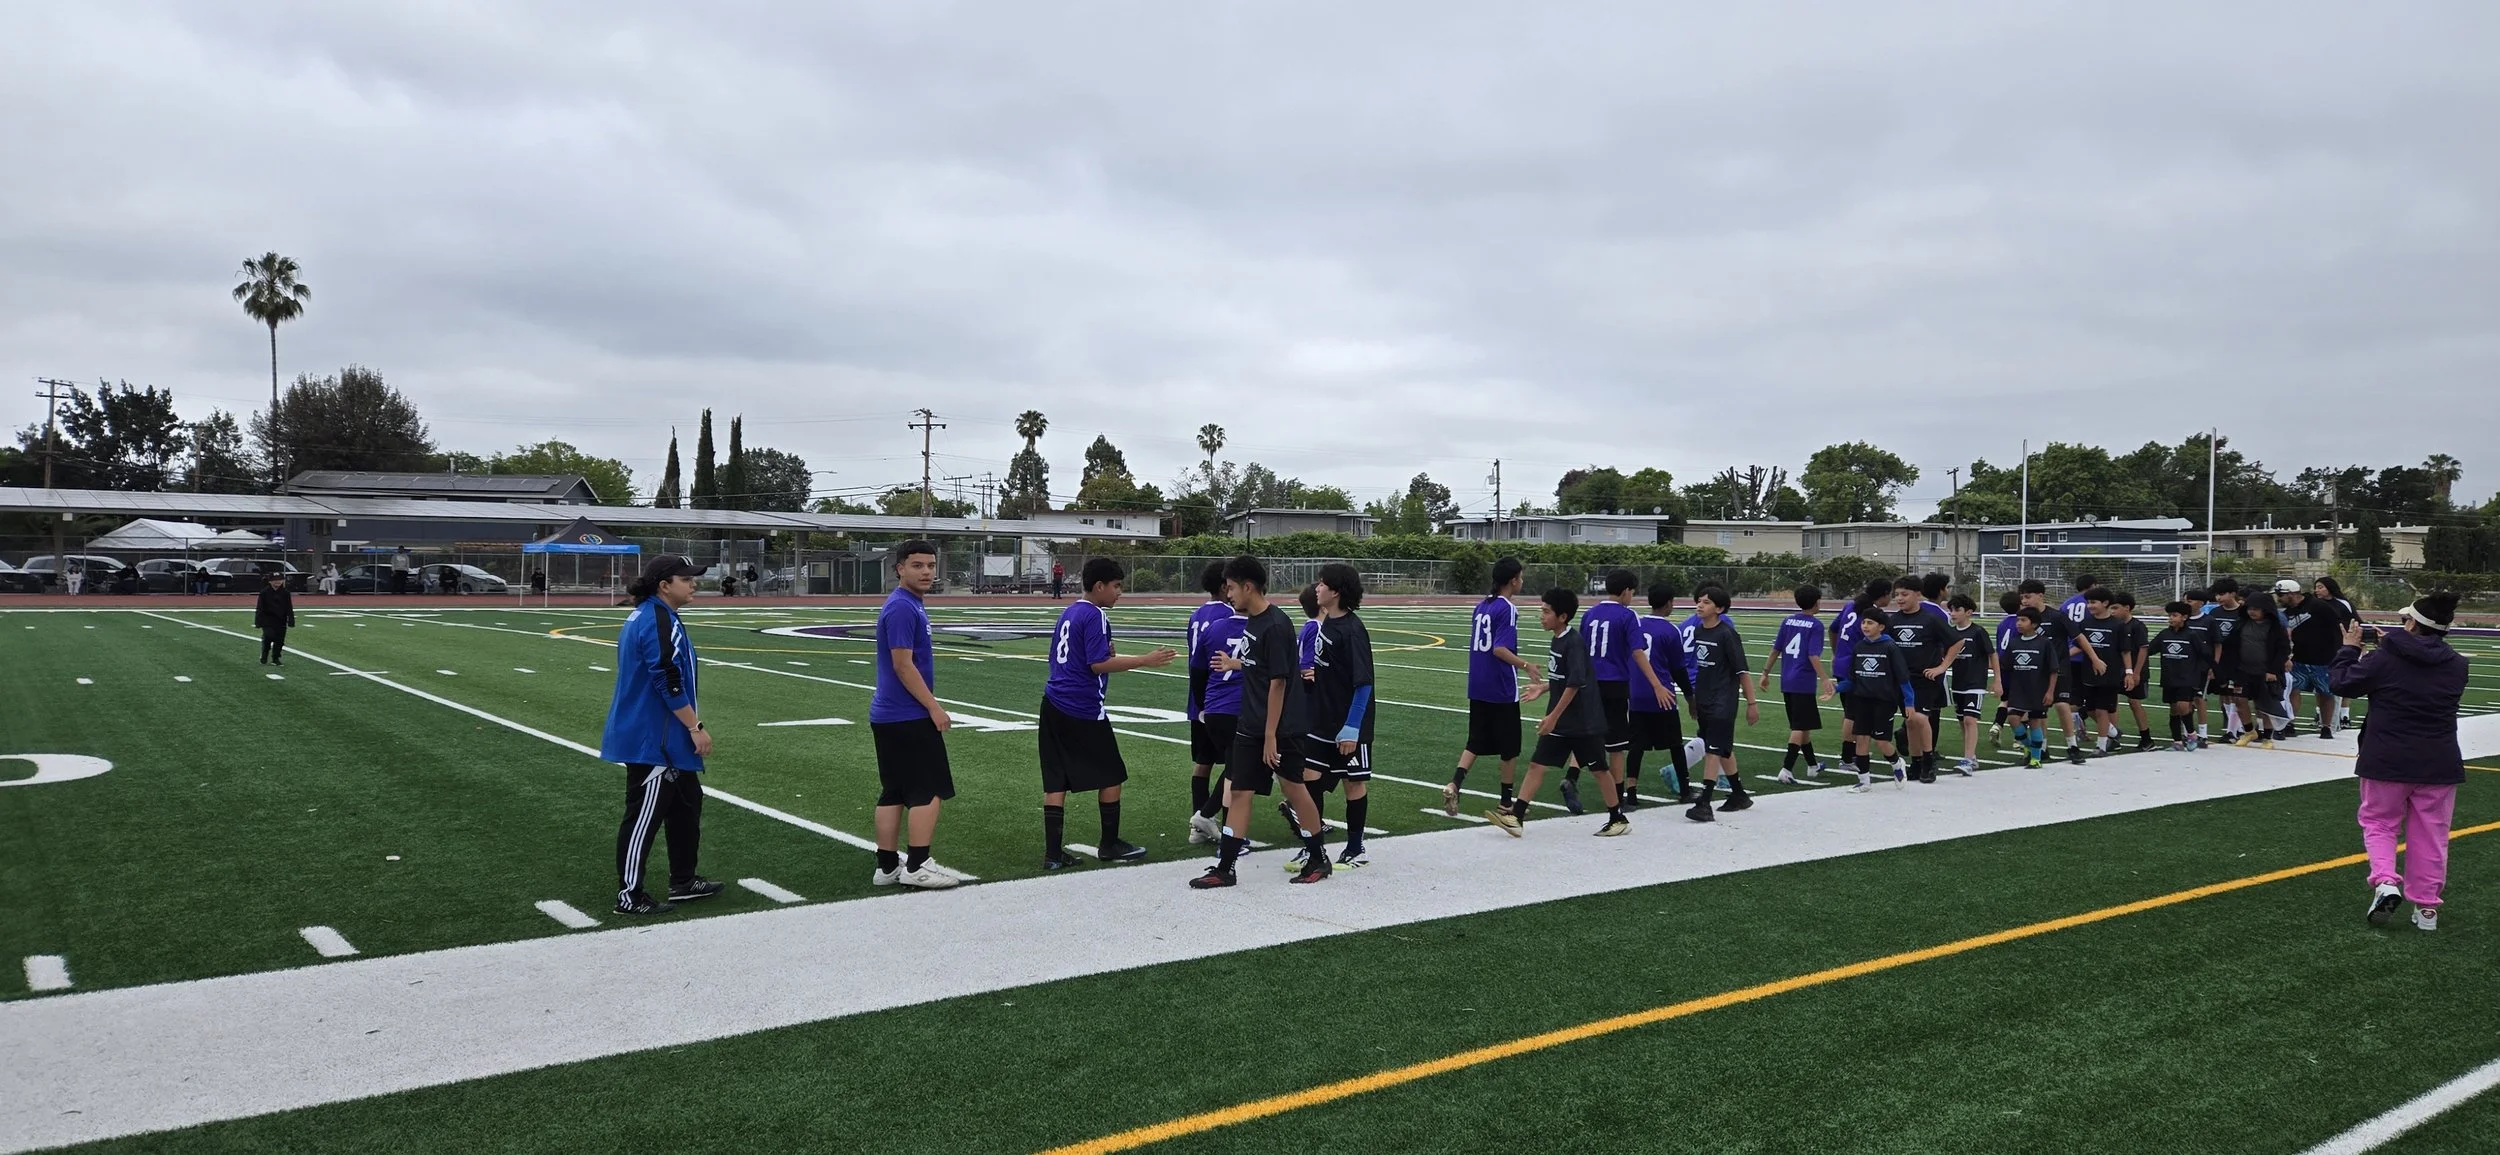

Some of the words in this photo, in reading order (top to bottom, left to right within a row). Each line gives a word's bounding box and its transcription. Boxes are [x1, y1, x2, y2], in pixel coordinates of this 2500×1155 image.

[1840, 612, 1857, 641] 2
[2067, 602, 2086, 622] 19
[1057, 620, 1071, 664] 8
[1473, 613, 1492, 652] 13
[1589, 619, 1610, 657] 11
[1683, 625, 1695, 653] 2
[1785, 632, 1801, 659] 4
[1222, 638, 1243, 681] 7
